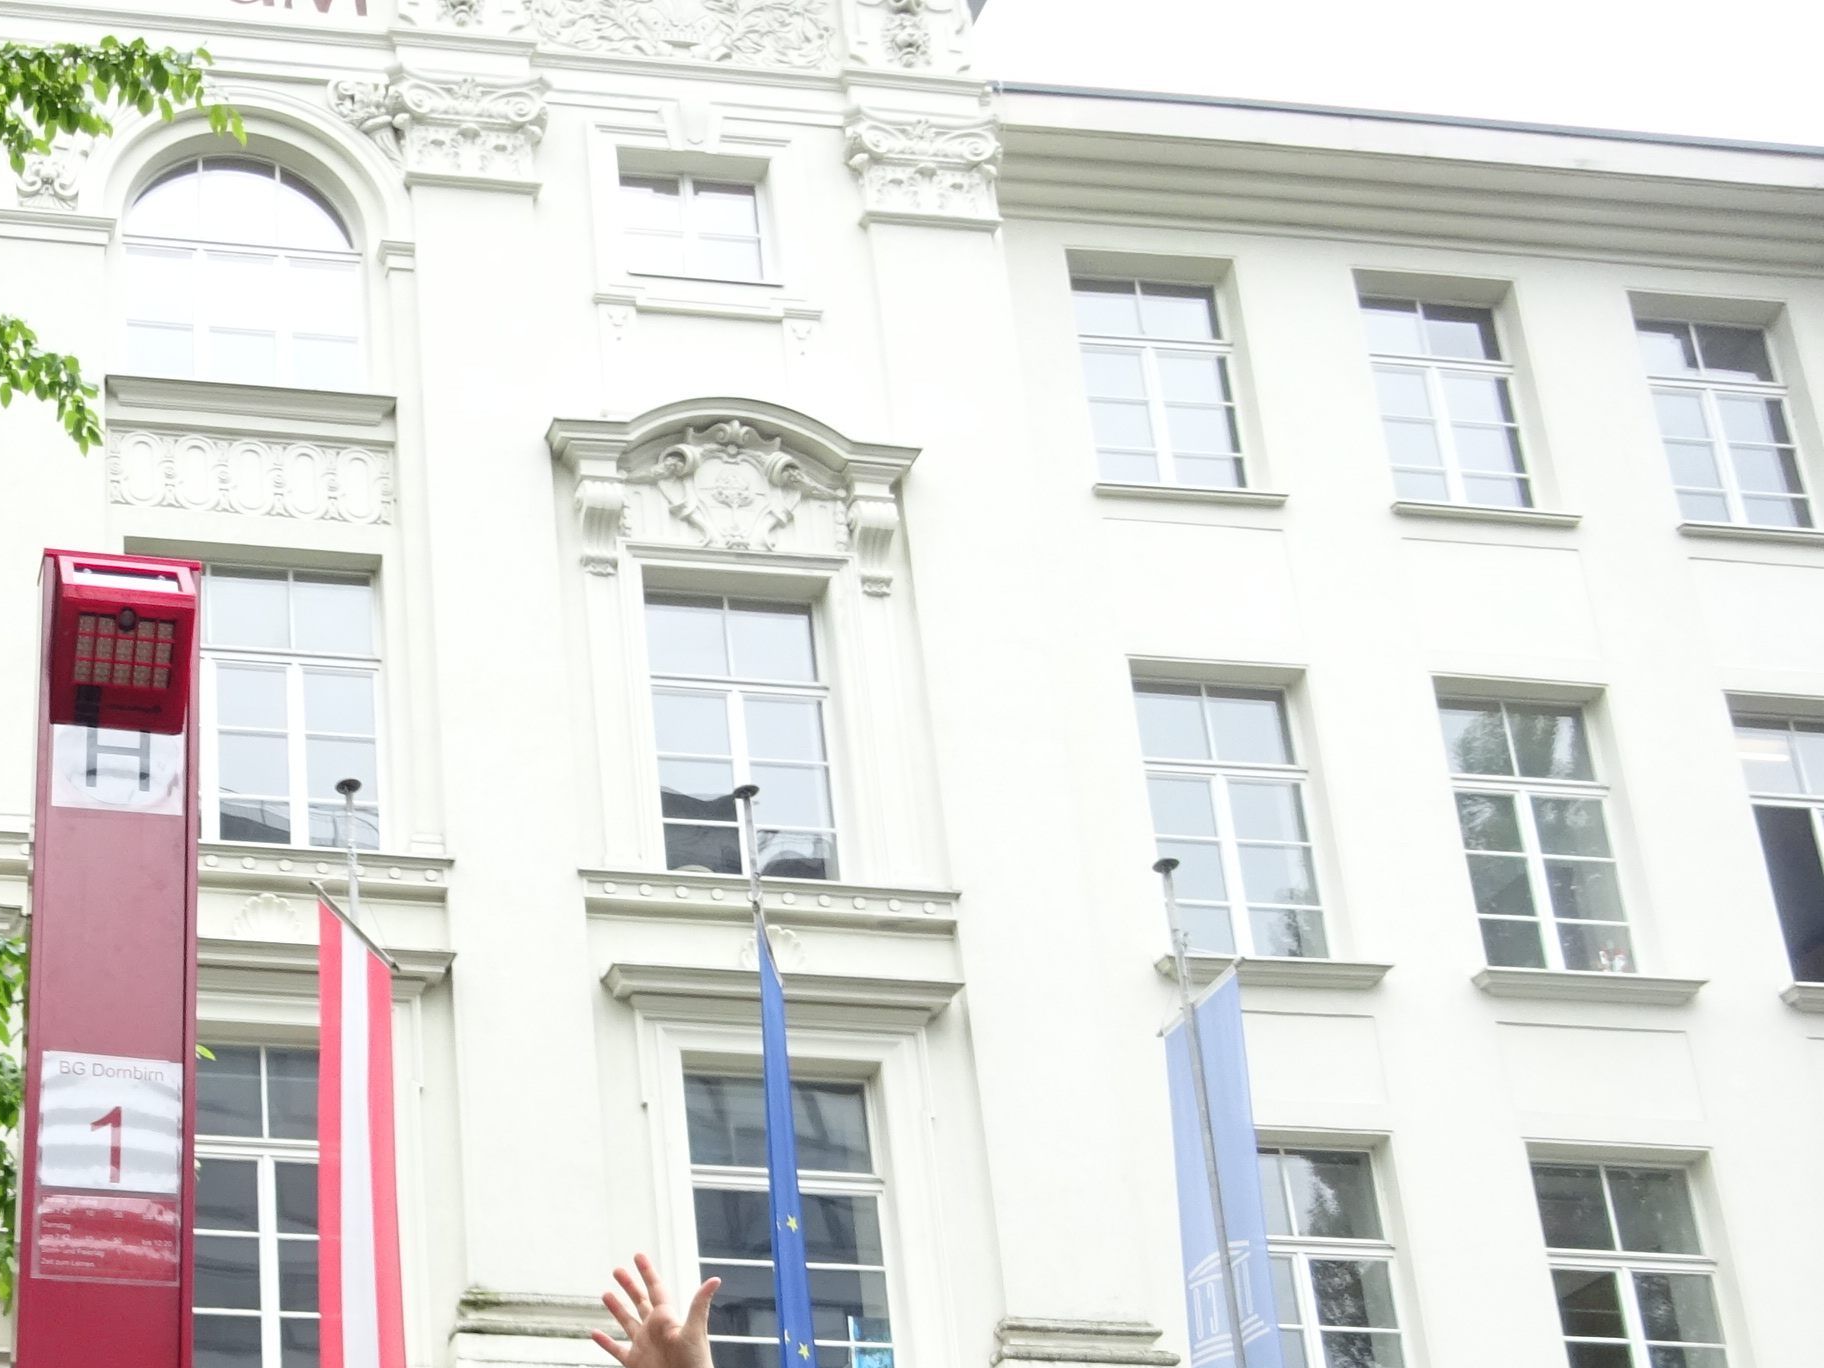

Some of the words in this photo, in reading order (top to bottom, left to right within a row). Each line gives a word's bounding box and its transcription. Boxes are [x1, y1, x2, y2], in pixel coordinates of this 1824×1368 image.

[58, 1060, 86, 1076] BG
[92, 1062, 165, 1082] Dornbirn
[90, 1106, 122, 1184] 1
